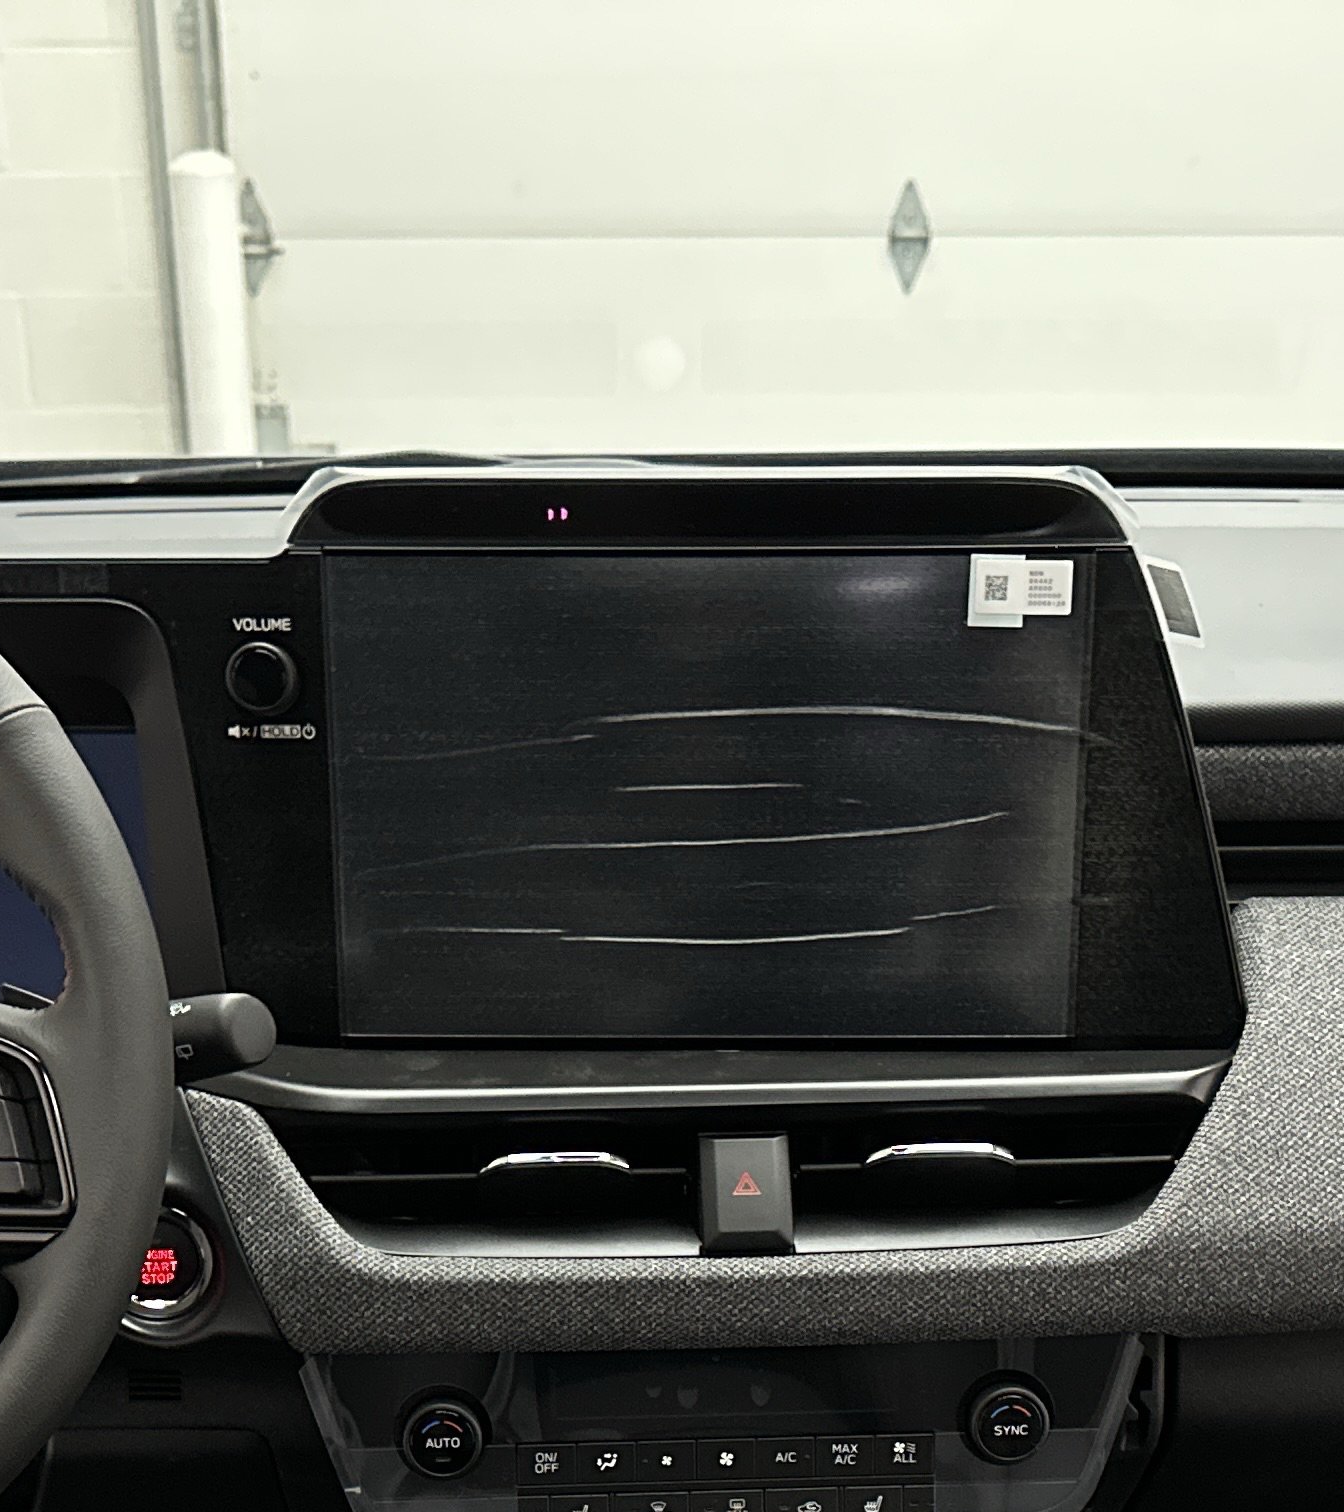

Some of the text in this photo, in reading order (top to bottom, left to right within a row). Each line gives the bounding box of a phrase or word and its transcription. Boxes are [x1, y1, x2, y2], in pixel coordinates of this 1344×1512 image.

[232, 617, 292, 631] VOLUME
[261, 726, 301, 738] HOLD
[140, 1260, 178, 1273] TART
[141, 1272, 175, 1285] STOP
[993, 1424, 1029, 1436] SYNC
[425, 1437, 461, 1449] AUTO
[832, 1443, 859, 1454] MAX
[535, 1452, 558, 1463] ON/
[775, 1451, 797, 1463] A/C
[834, 1454, 857, 1465] A/C
[893, 1452, 917, 1463] ALL
[534, 1463, 559, 1474] OFF
